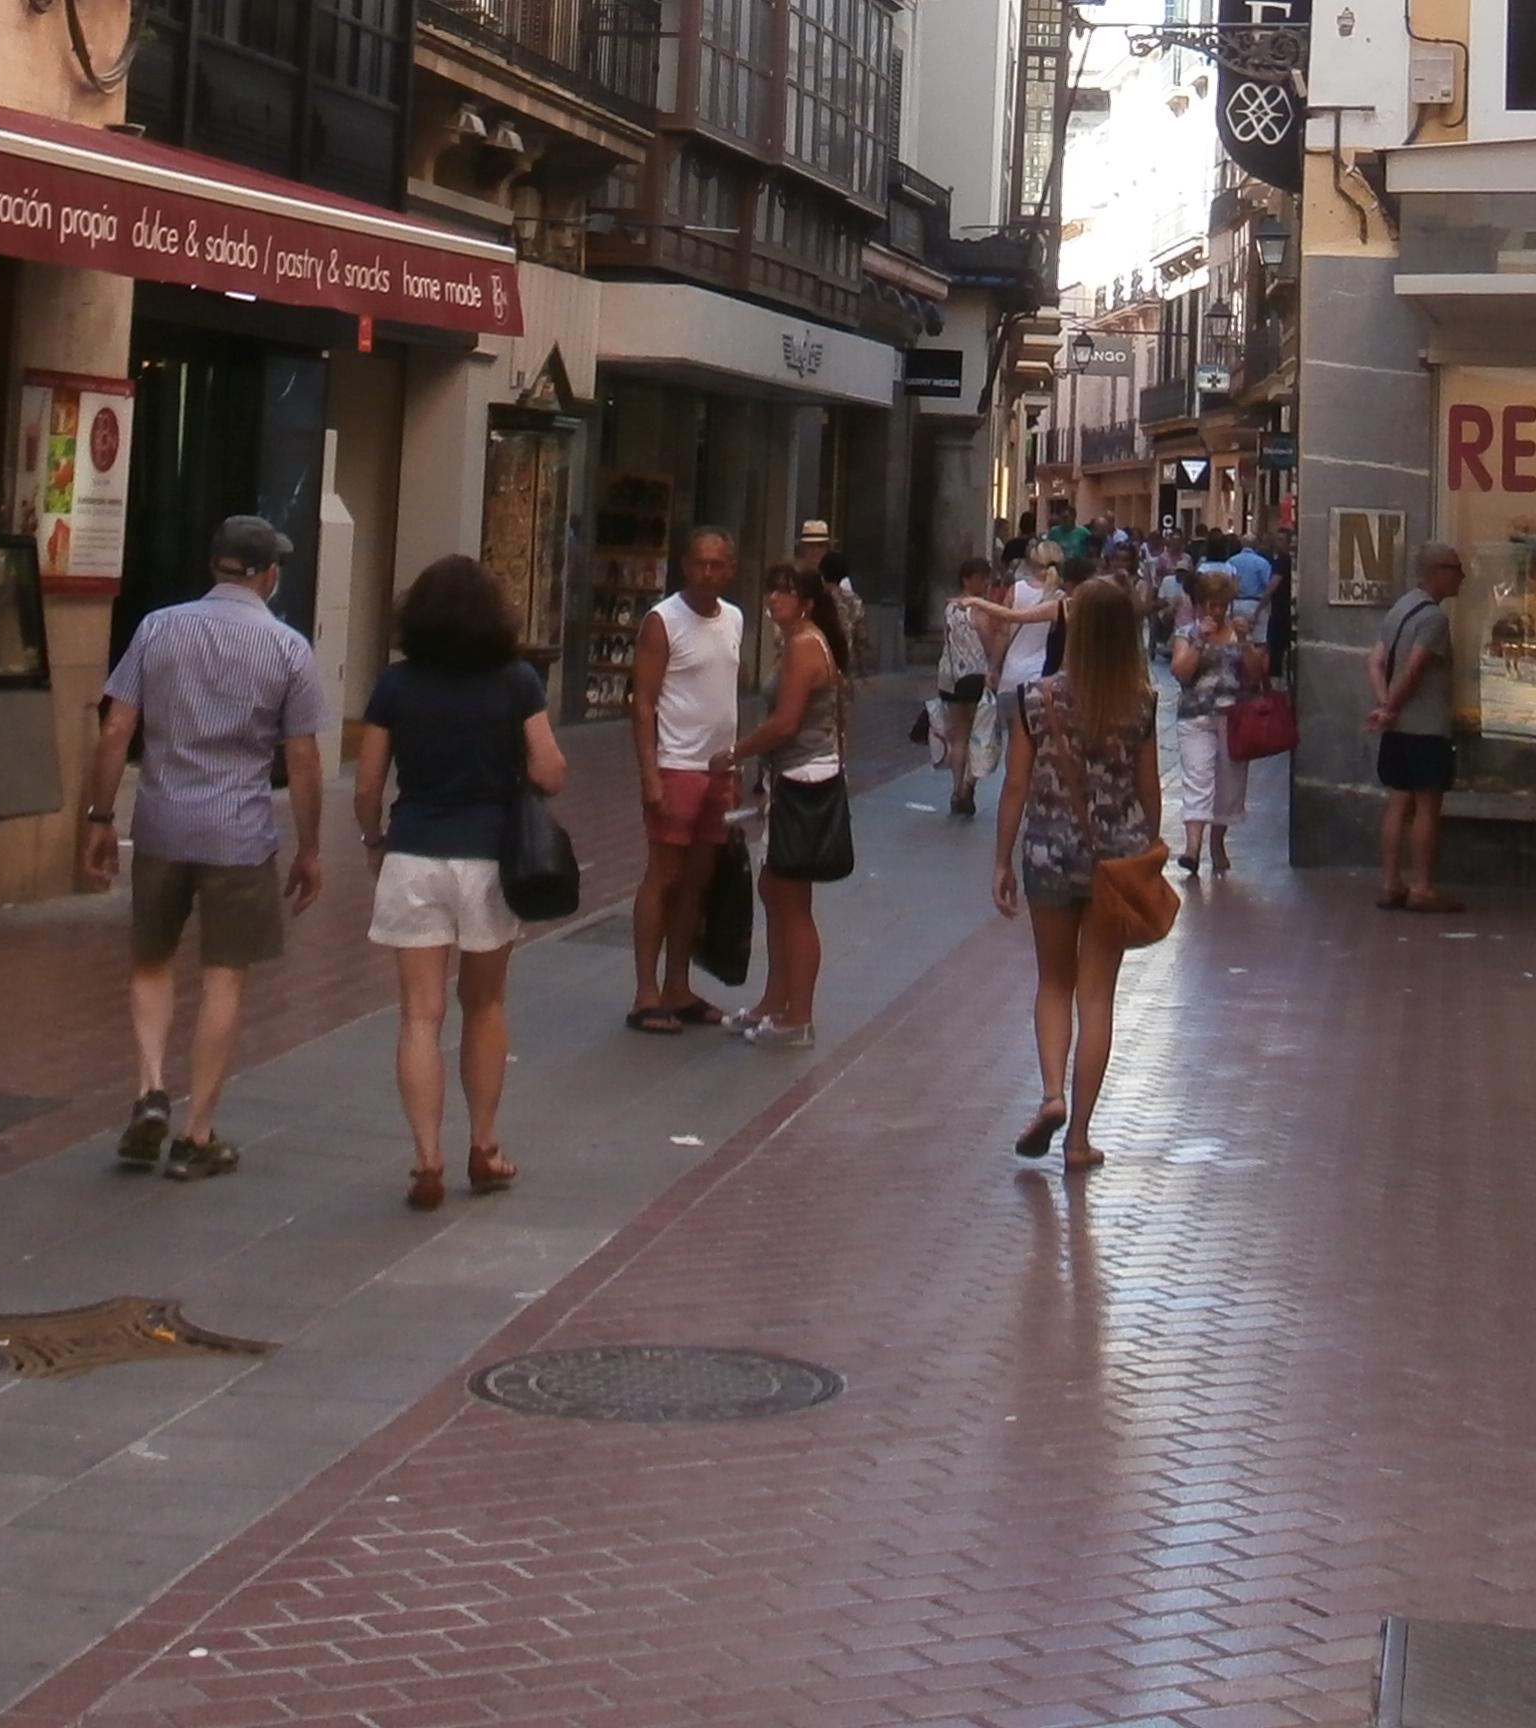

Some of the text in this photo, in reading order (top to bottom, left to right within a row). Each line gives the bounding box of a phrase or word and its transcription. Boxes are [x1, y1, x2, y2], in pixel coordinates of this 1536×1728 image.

[60, 201, 118, 248] propia
[132, 206, 179, 255] dulce
[185, 219, 200, 258] &
[205, 224, 259, 269] salado
[276, 248, 324, 290] pastry
[328, 248, 340, 284] &
[344, 255, 391, 293] snacks
[403, 260, 441, 302] home
[445, 276, 483, 309] made
